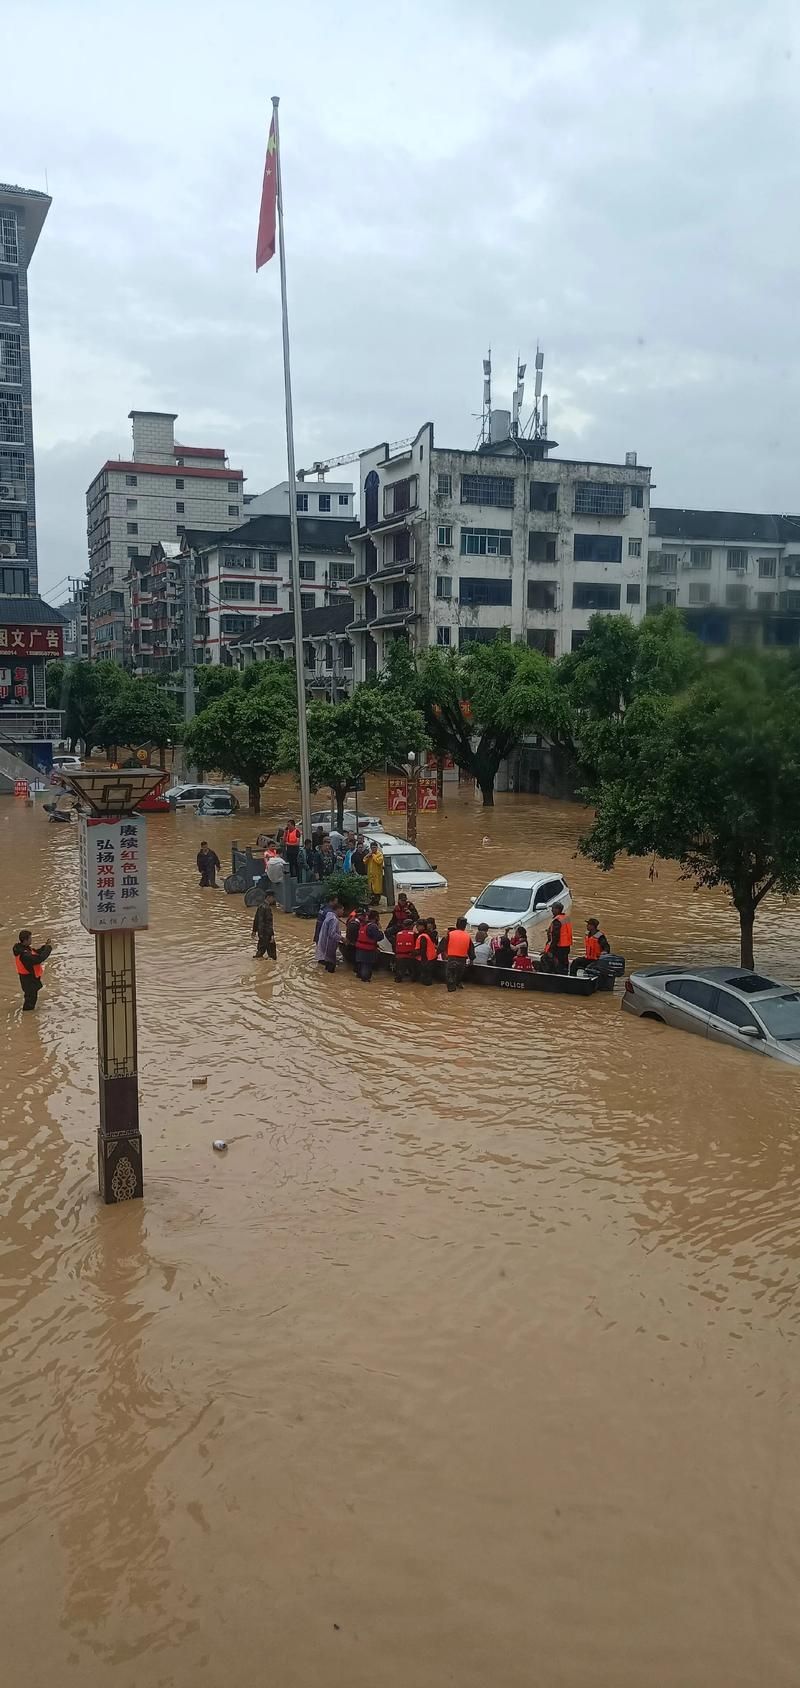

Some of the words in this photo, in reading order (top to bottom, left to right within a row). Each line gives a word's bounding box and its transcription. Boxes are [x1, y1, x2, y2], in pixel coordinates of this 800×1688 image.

[96, 839, 116, 913] 弘扬双拥传统
[120, 824, 139, 899] 赓续红色血脉
[500, 980, 525, 989] POLICE
